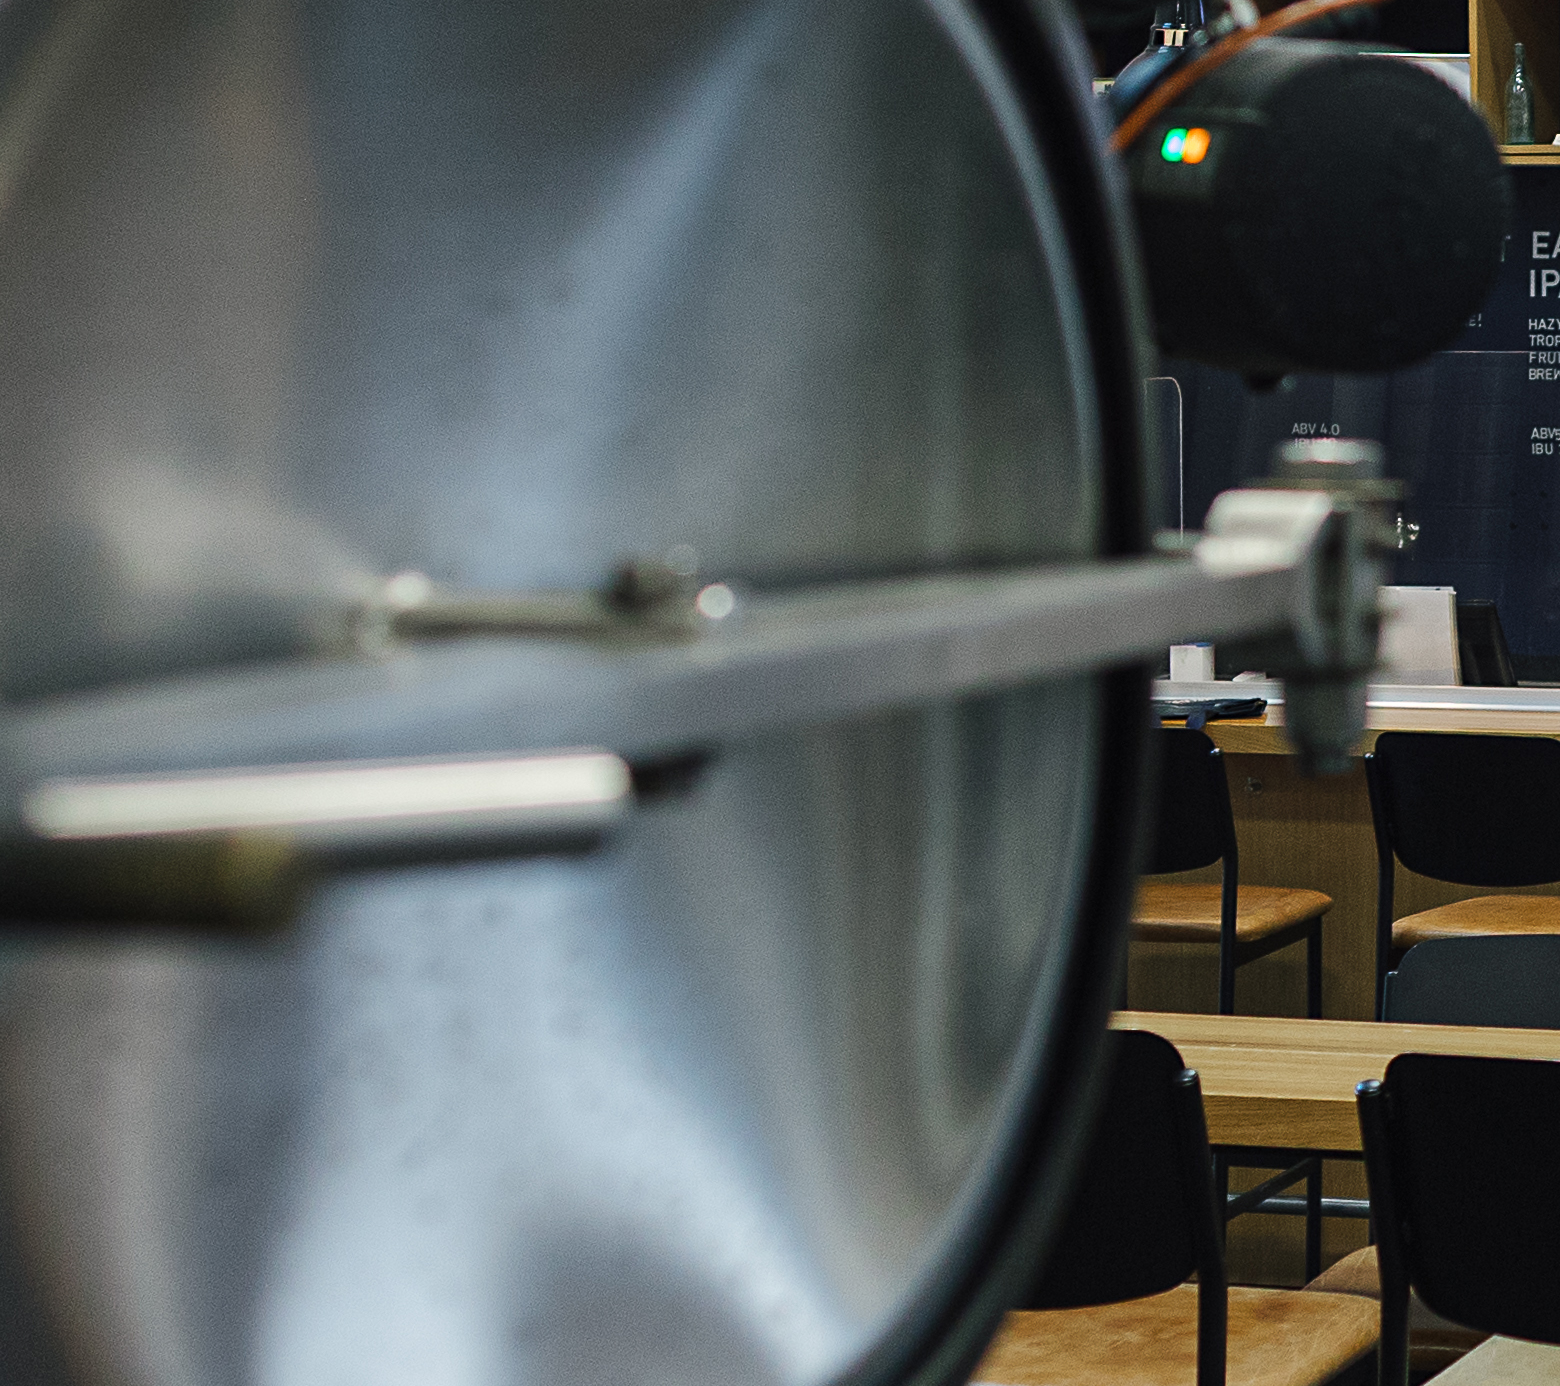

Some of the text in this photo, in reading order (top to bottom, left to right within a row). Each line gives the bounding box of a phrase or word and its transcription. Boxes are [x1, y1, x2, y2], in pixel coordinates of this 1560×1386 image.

[1291, 423, 1340, 435] ABV 4.0
[1531, 444, 1553, 454] IBU
